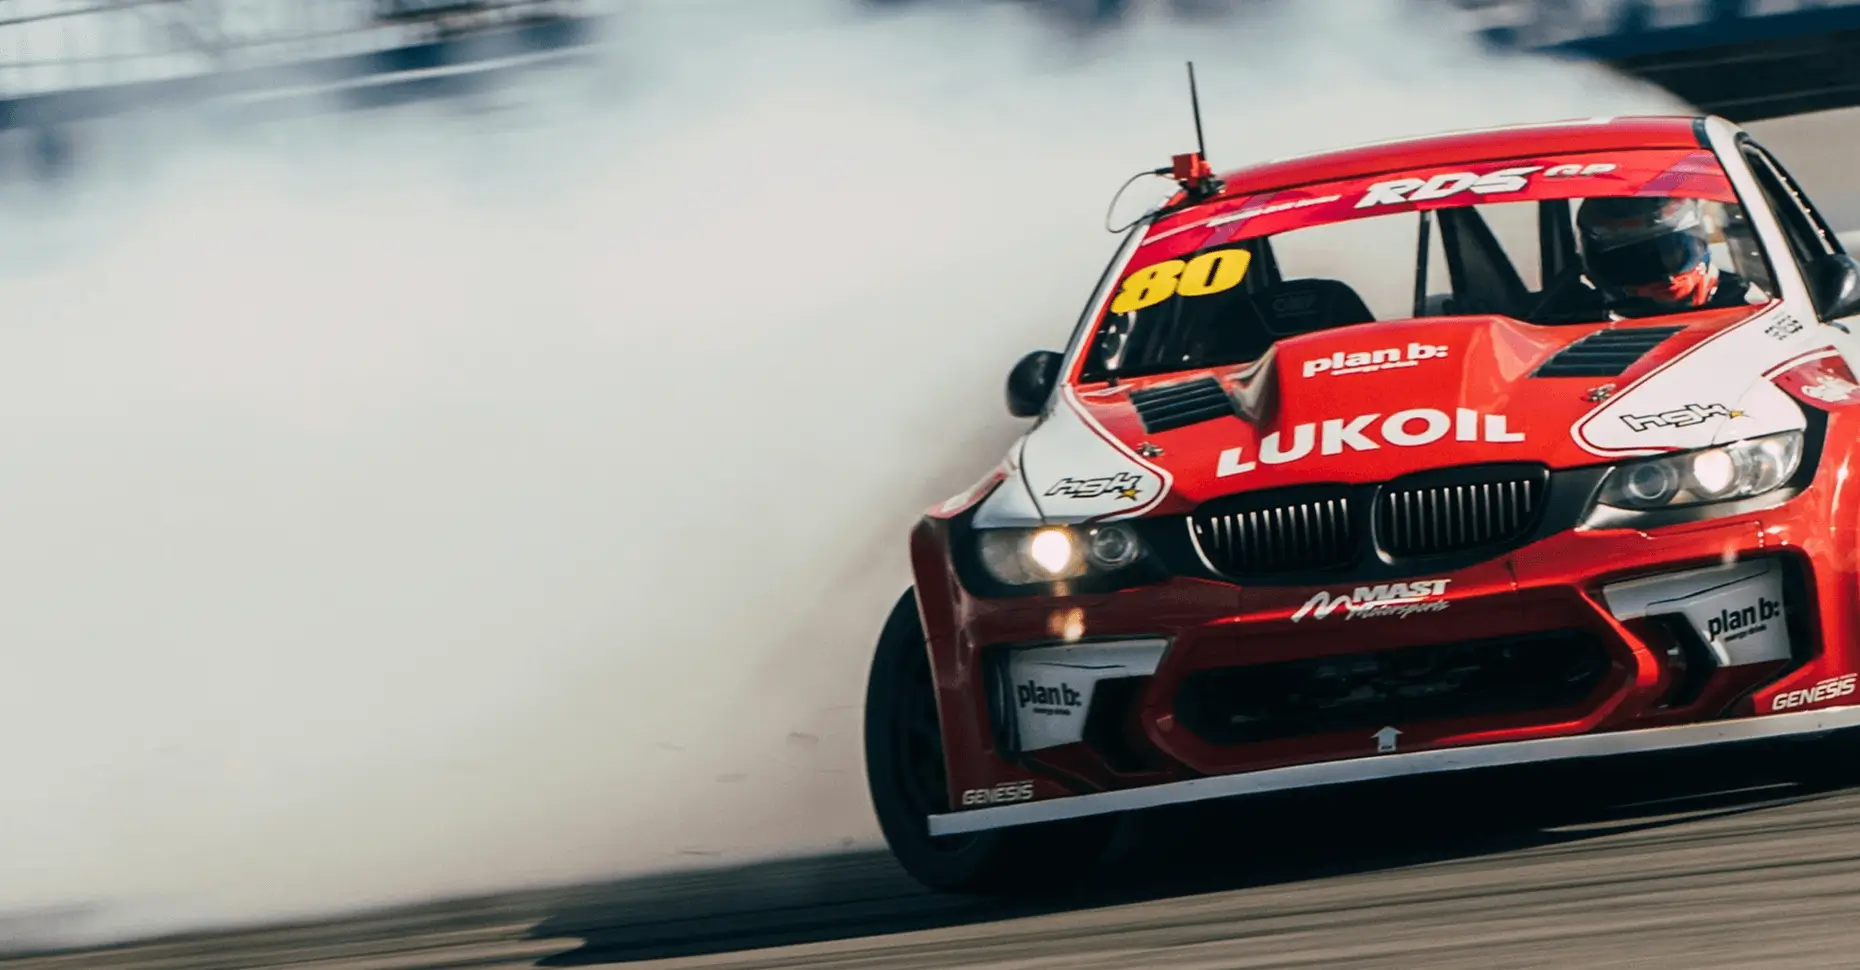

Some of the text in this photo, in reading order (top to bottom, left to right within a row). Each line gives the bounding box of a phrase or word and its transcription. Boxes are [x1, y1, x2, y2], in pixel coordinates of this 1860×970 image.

[1354, 165, 1544, 209] RDS
[1110, 248, 1252, 314] 80
[1302, 348, 1401, 378] plan
[1407, 342, 1449, 360] b:
[1619, 403, 1730, 432] hgk
[1216, 407, 1526, 477] LUKOIL
[1353, 579, 1452, 602] MAST
[1707, 606, 1757, 642] plan
[1758, 597, 1780, 621] b:
[1017, 679, 1062, 708] plan
[1771, 677, 1857, 711] GENESIS
[962, 783, 1034, 806] GENESIS
